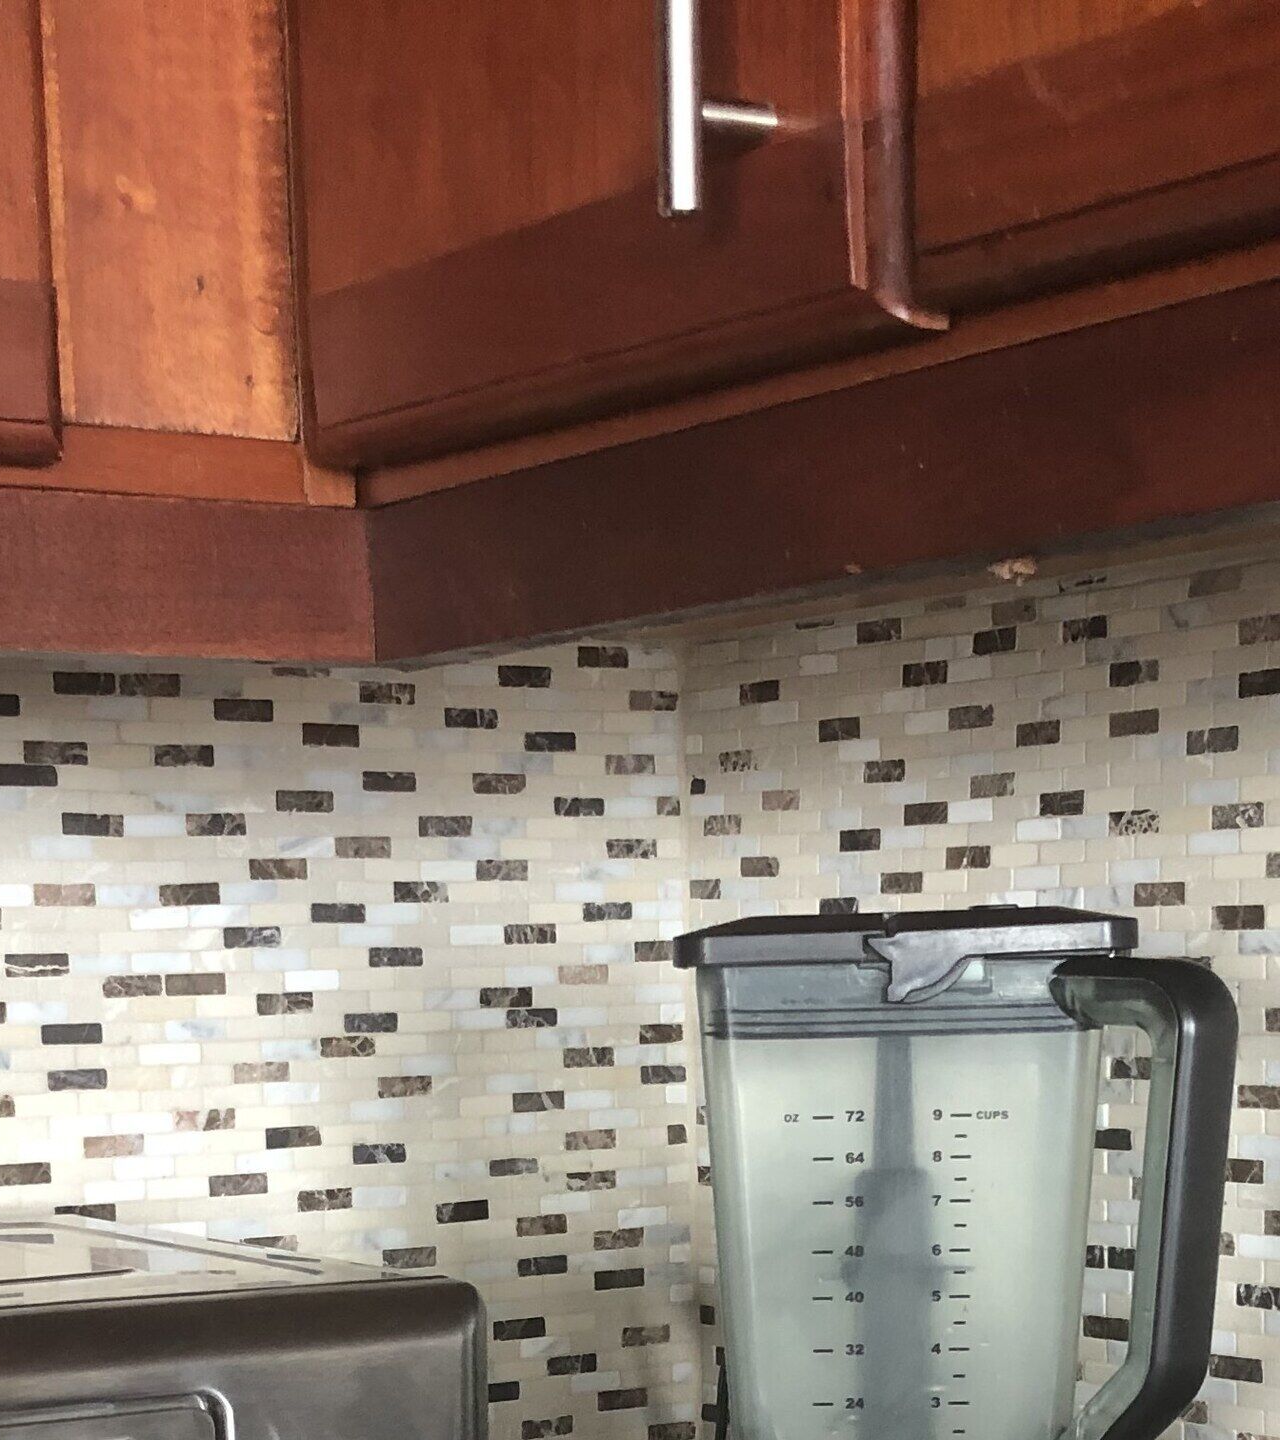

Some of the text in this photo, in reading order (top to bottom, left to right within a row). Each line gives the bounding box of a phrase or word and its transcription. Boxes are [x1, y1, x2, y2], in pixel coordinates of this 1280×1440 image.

[784, 1110, 865, 1123] OZ 72
[933, 1109, 1009, 1121] 9 CUPS
[845, 1152, 865, 1164] 64
[933, 1150, 942, 1162] 8
[845, 1196, 864, 1208] 56
[931, 1195, 942, 1206] 7
[844, 1245, 865, 1257] 48
[932, 1244, 942, 1256] 6
[845, 1291, 865, 1303] 40
[931, 1290, 941, 1302] 5
[845, 1343, 865, 1355] 32
[931, 1343, 941, 1355] 4
[845, 1398, 865, 1409] 24
[931, 1397, 941, 1408] 3
